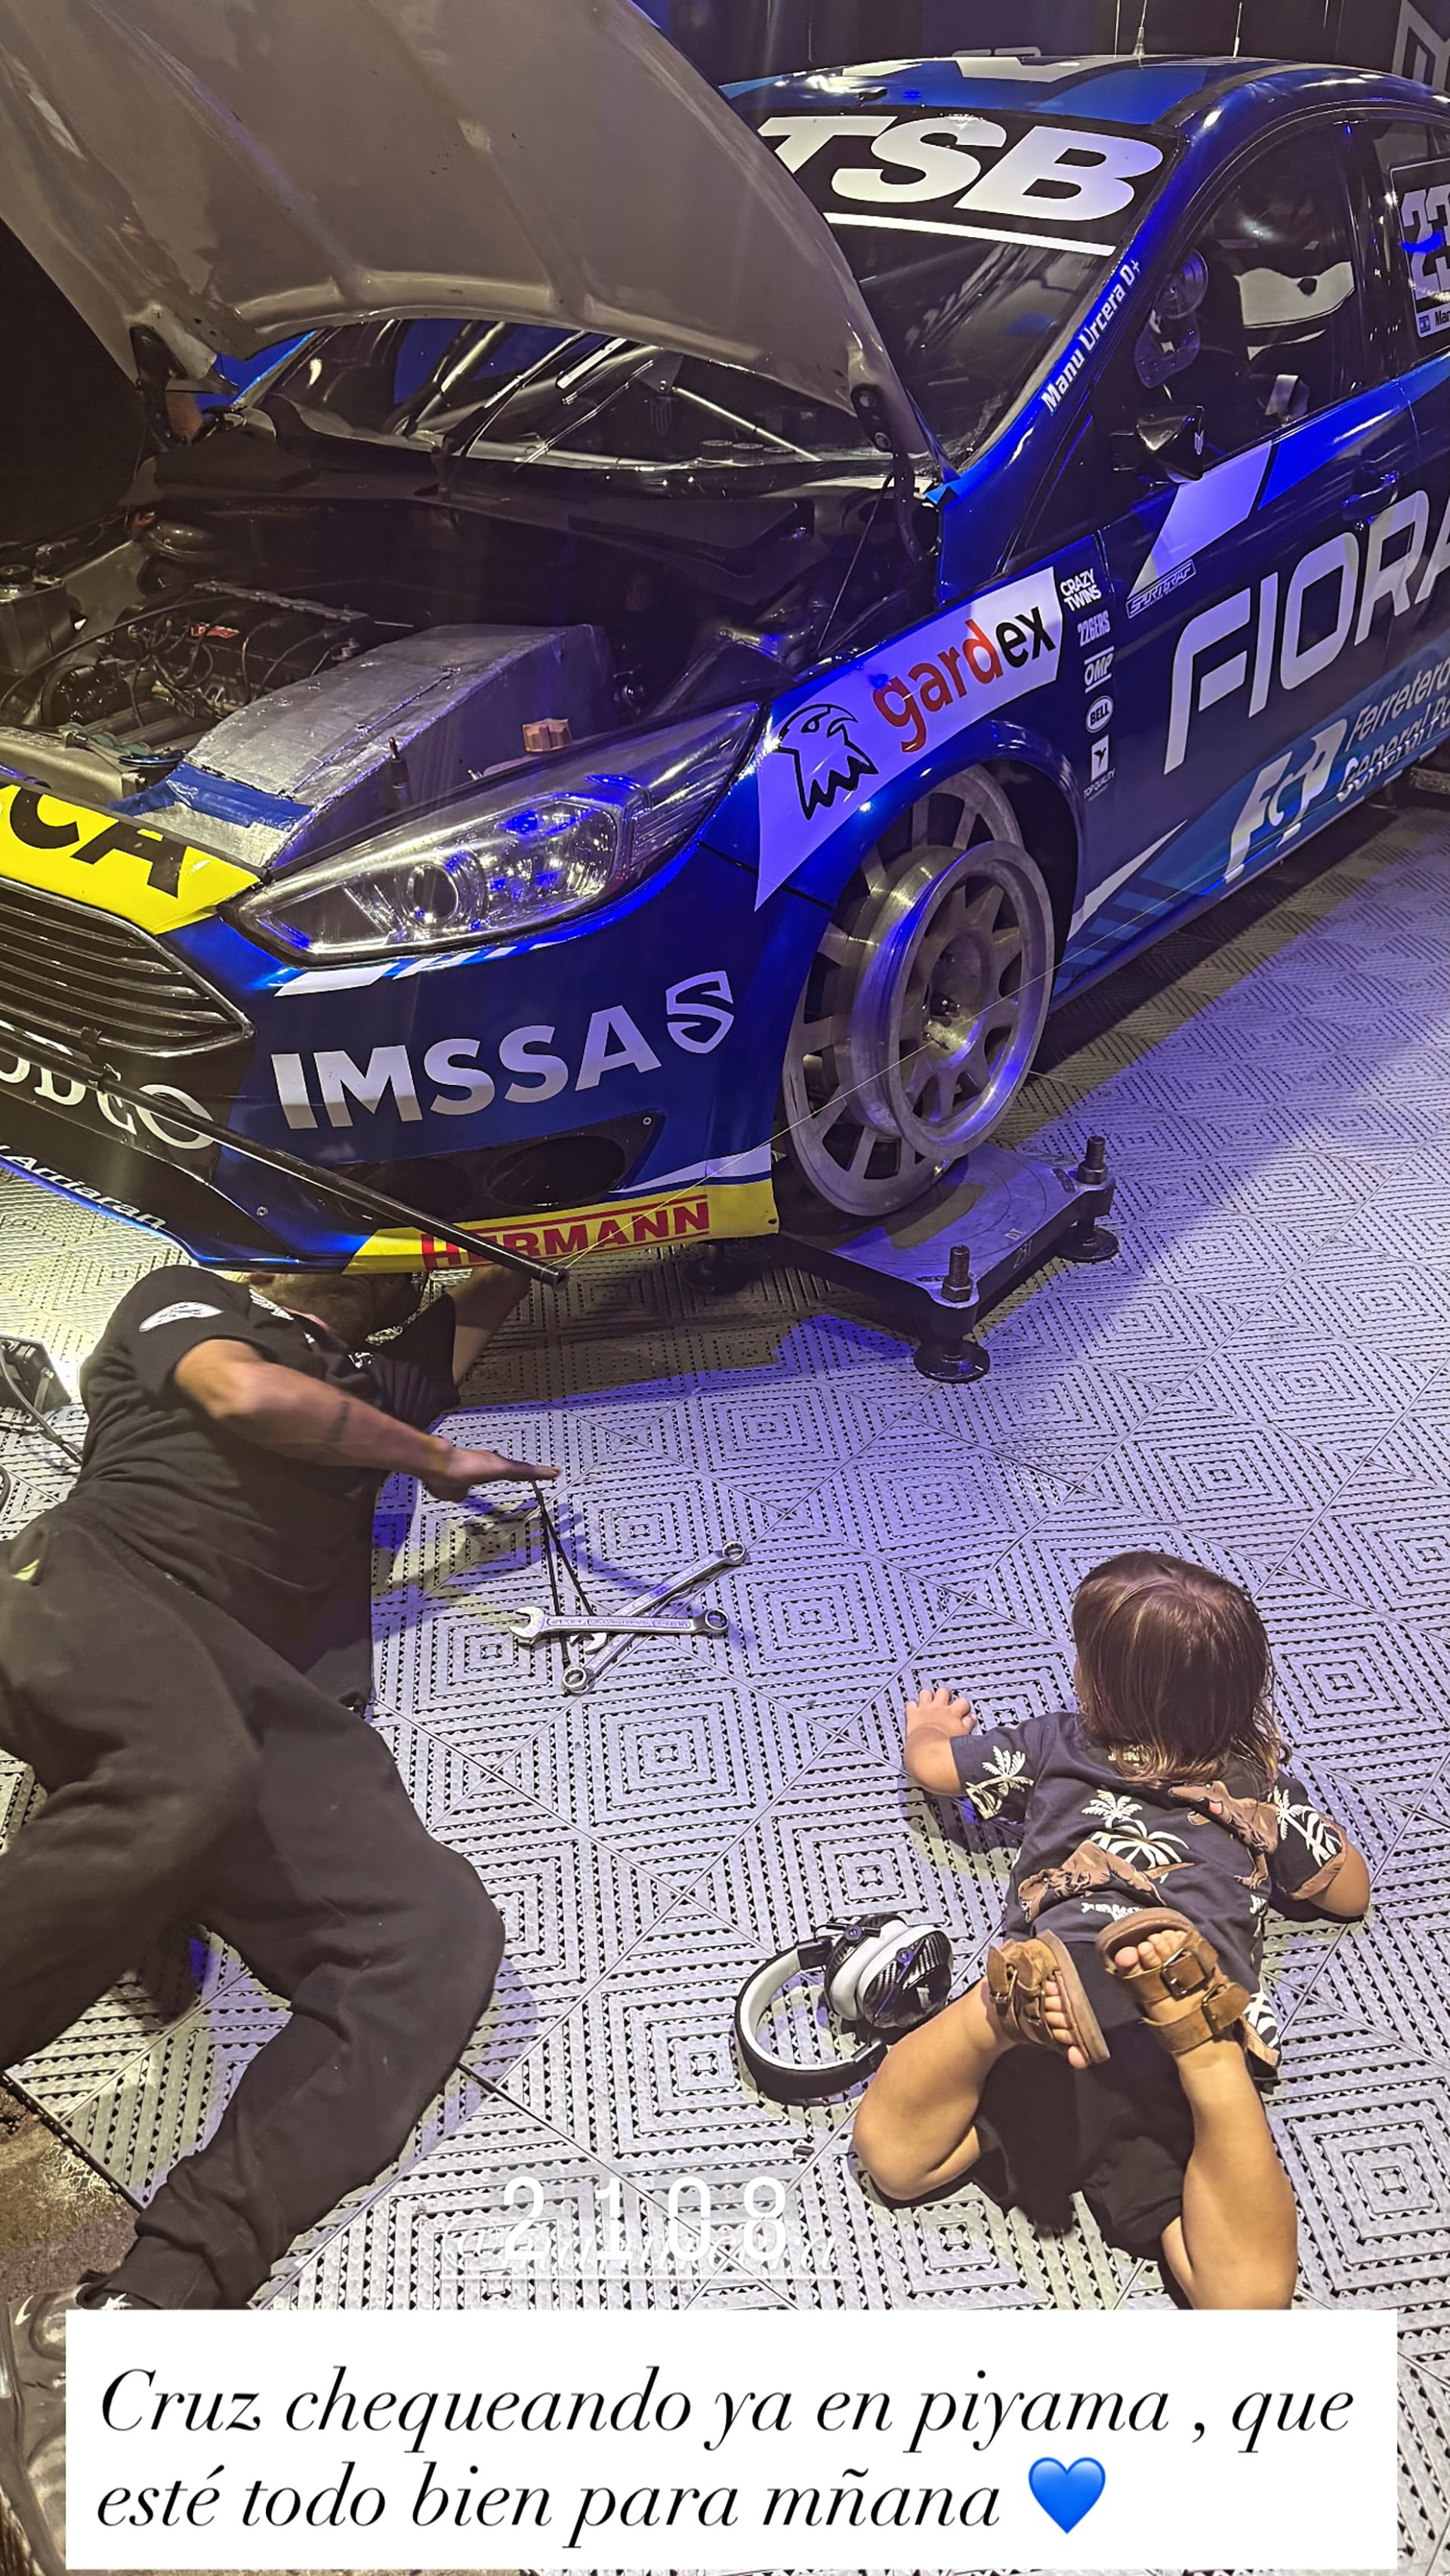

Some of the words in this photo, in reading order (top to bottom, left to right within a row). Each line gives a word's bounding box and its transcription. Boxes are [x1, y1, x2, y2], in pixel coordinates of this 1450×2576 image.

[757, 116, 1164, 221] TSB
[1041, 350, 1085, 413] Manu
[1078, 284, 1126, 352] Urcera
[1060, 568, 1095, 597] CRAZY
[1063, 584, 1102, 612] TWINS
[1077, 610, 1111, 647] 226ERS
[872, 606, 1057, 753] gardex
[1084, 652, 1114, 687] OMP
[1089, 702, 1110, 726] BELL
[1094, 768, 1115, 790] QUALITY
[270, 1005, 662, 1129] IMSSA
[420, 1202, 710, 1271] HRMANN
